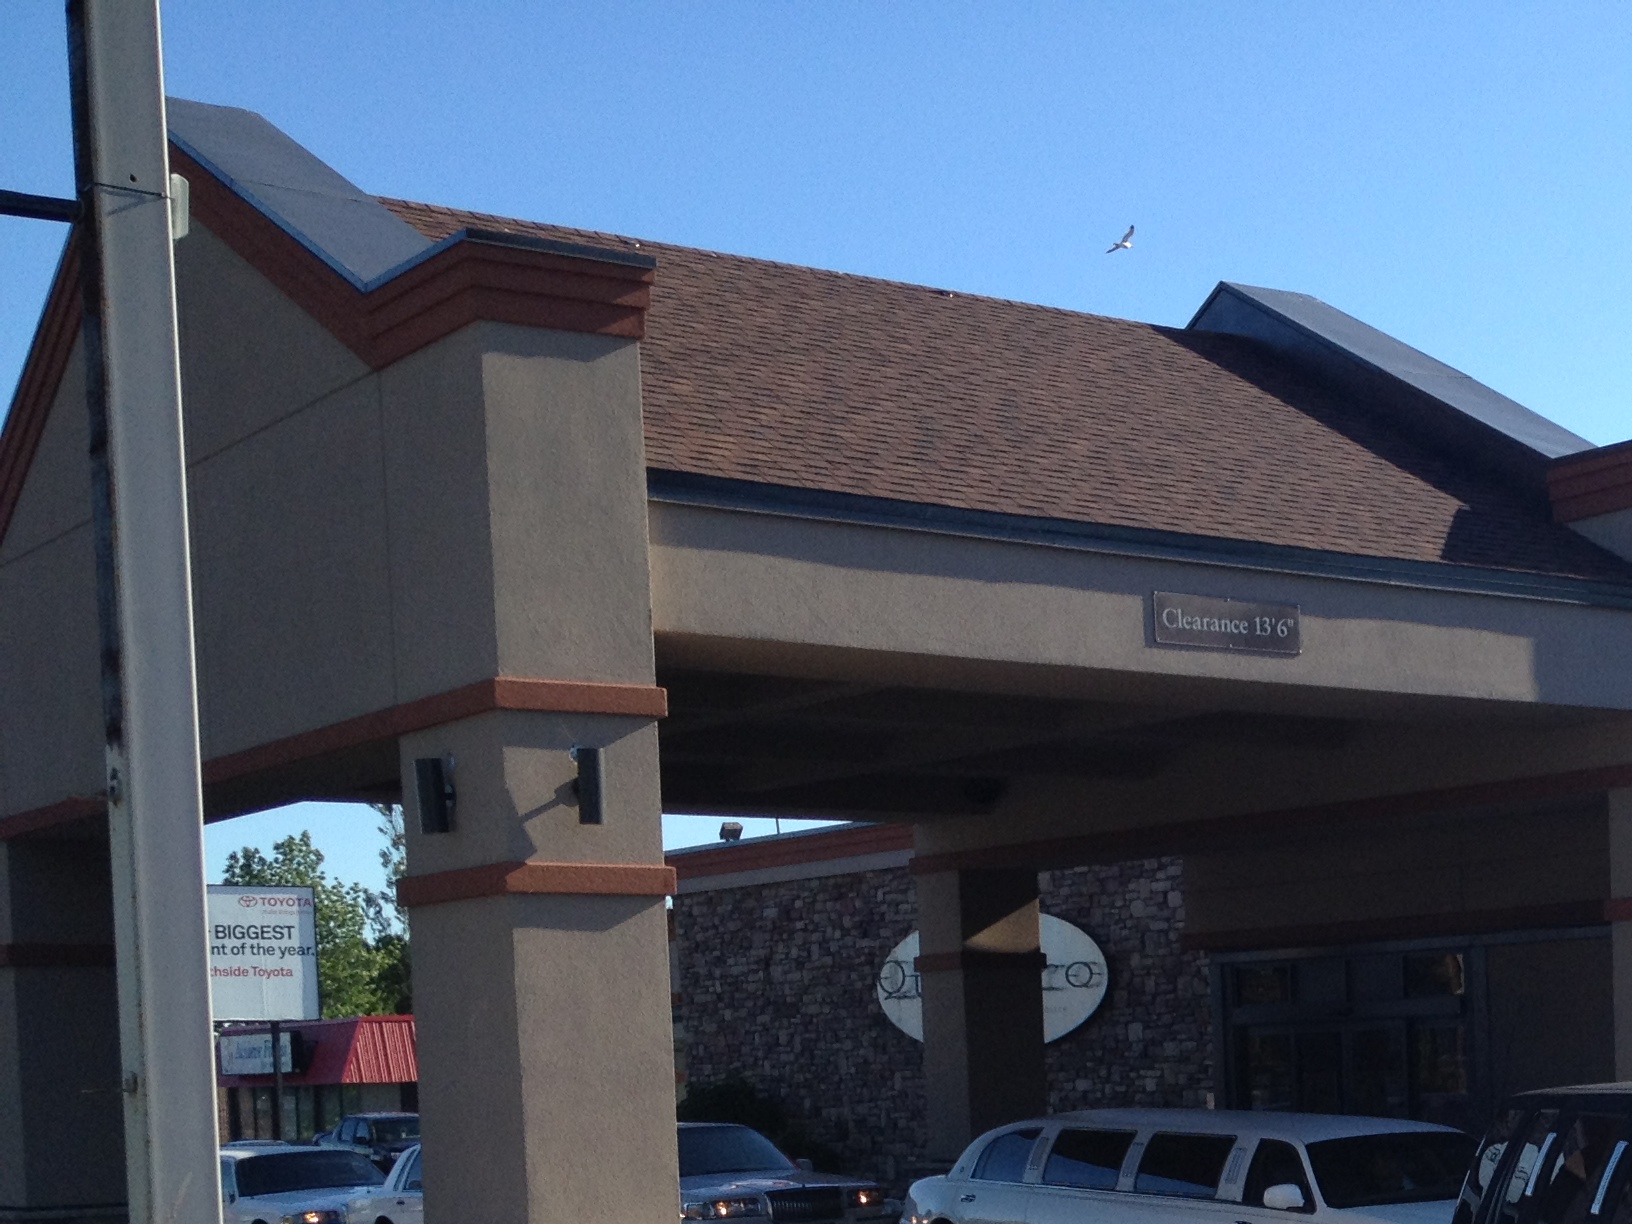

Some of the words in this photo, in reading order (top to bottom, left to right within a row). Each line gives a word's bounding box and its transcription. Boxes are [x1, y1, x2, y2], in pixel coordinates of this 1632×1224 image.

[1162, 607, 1249, 634] Clearance
[259, 897, 312, 907] TOYOTA
[214, 924, 296, 940] BIGGEST
[211, 943, 228, 956] nt
[231, 942, 247, 956] of
[250, 942, 276, 956] the
[278, 945, 315, 959] year.
[251, 966, 293, 979] Toyota
